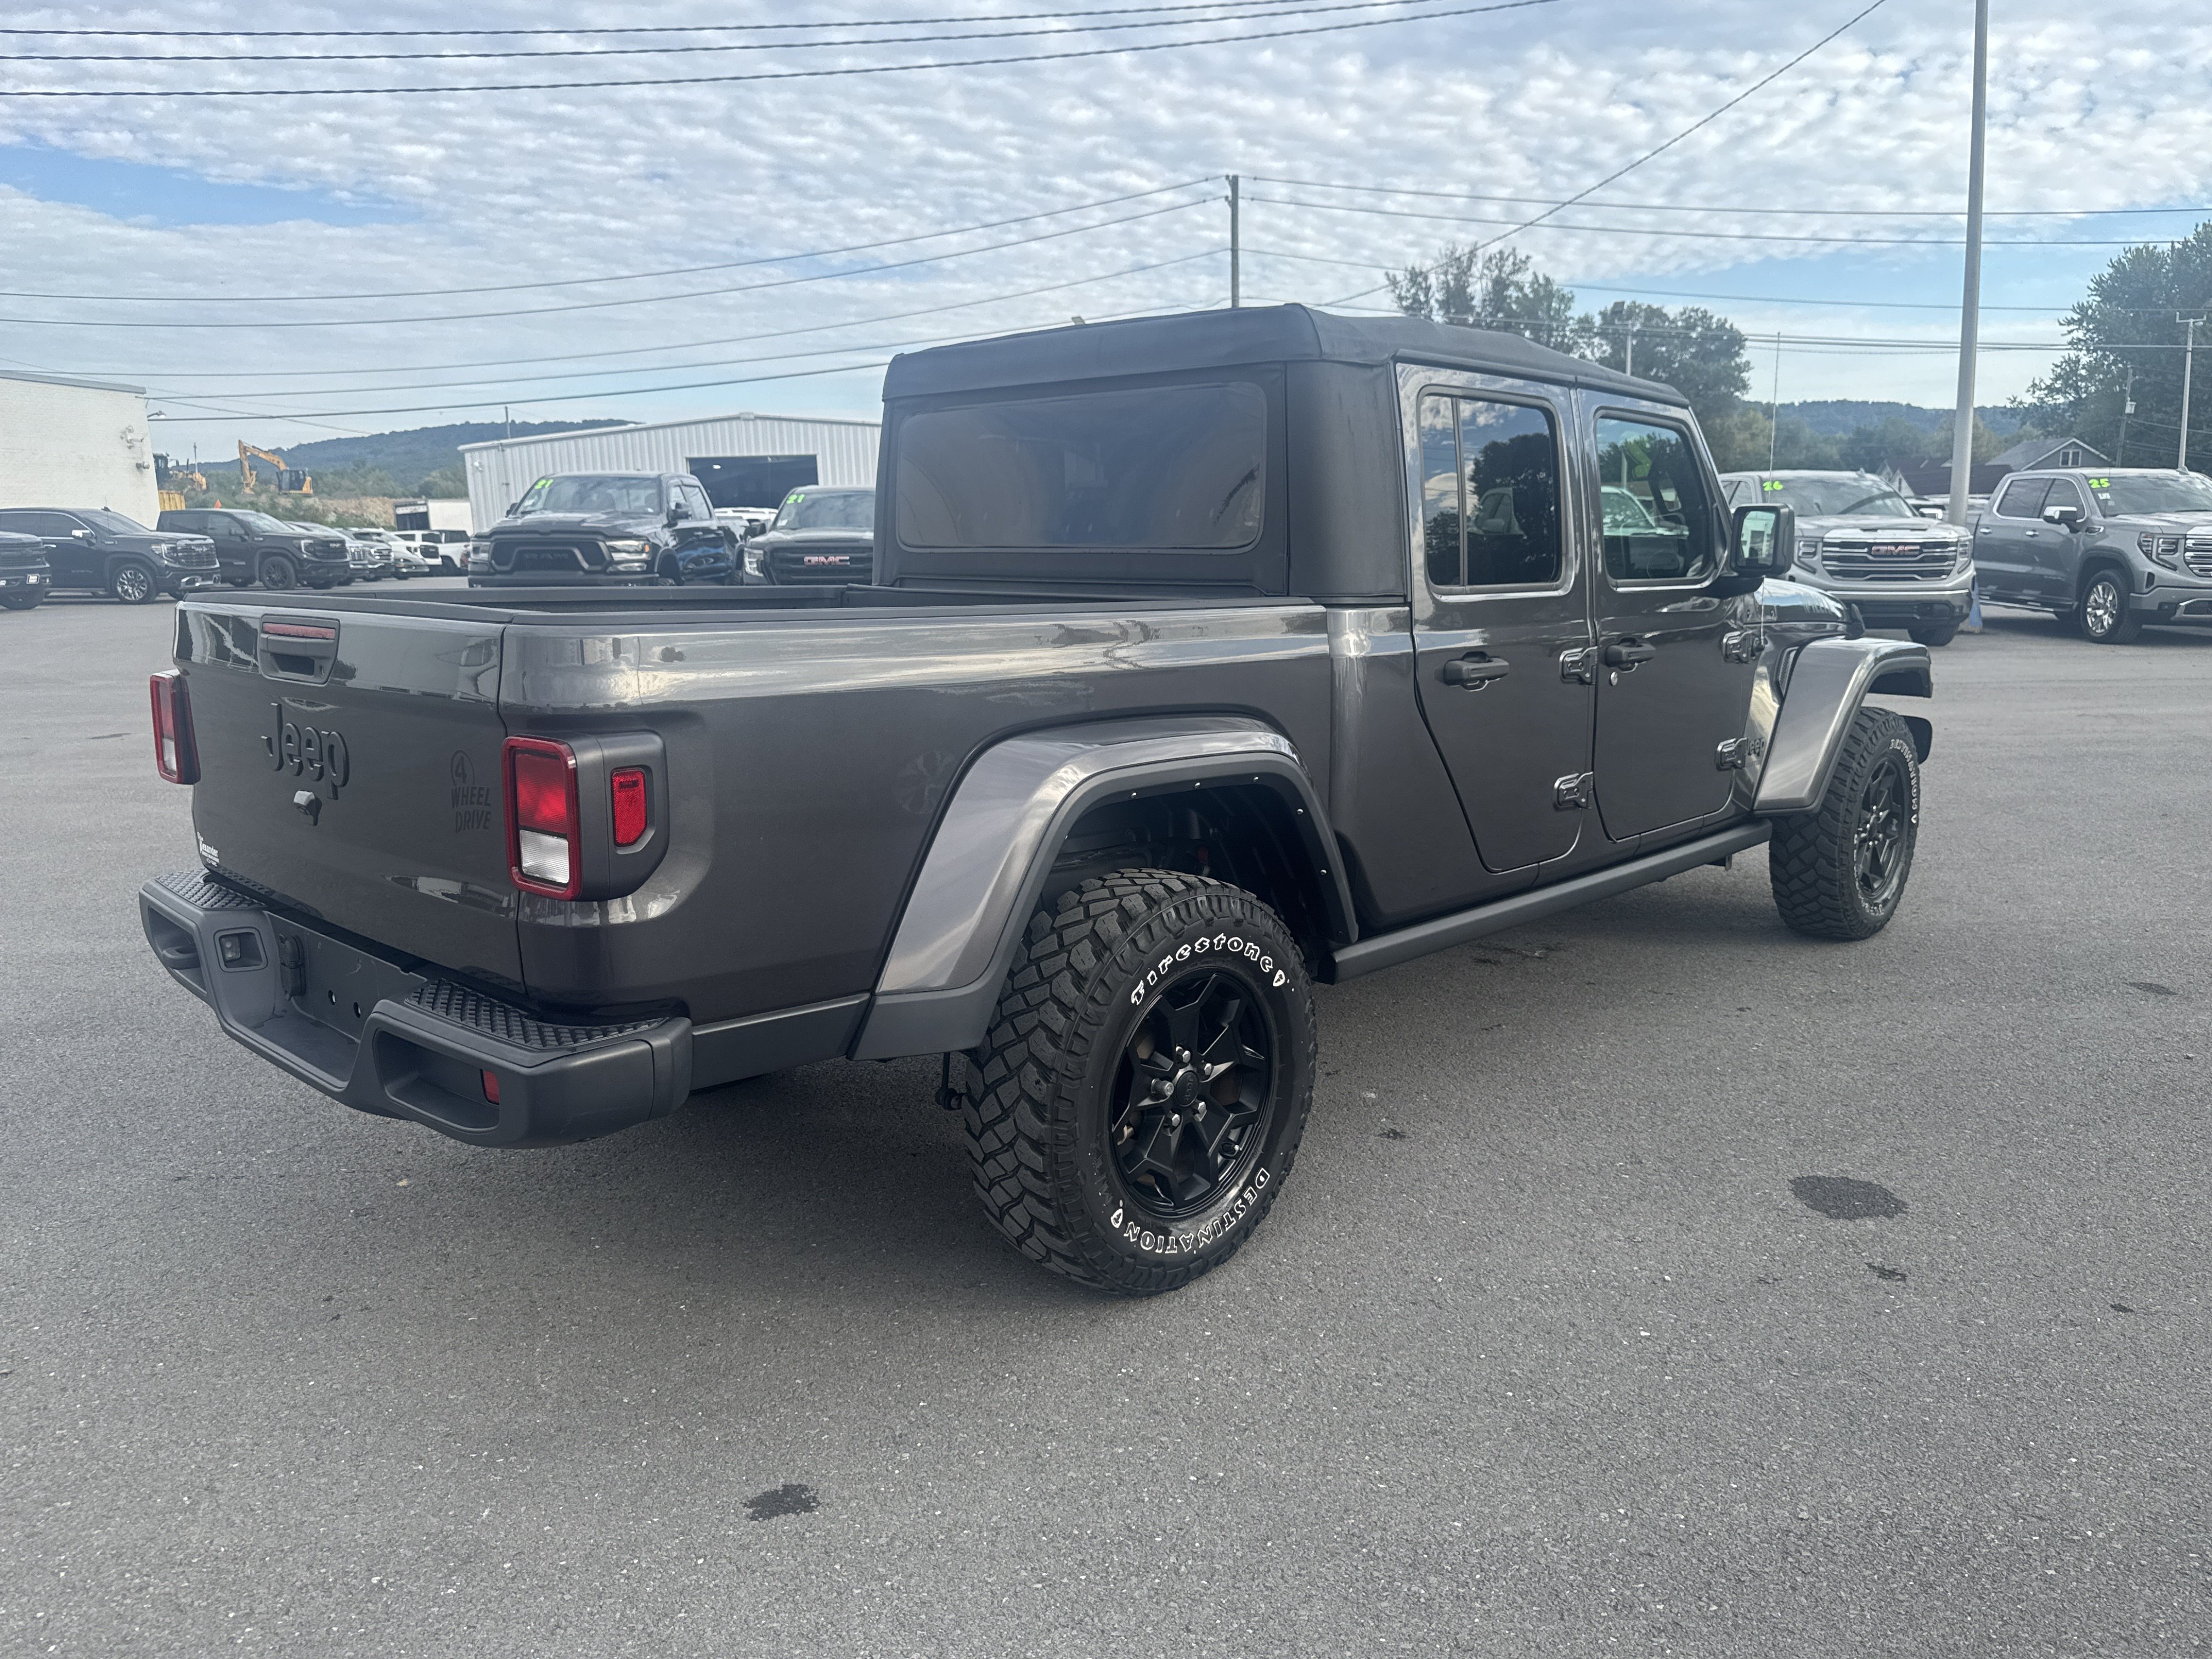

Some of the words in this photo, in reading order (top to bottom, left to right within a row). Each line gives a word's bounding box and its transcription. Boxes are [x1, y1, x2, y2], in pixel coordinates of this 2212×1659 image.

[1763, 481, 1783, 492] 26
[2089, 478, 2111, 488] 25
[786, 494, 805, 504] 21
[1871, 545, 1920, 555] GMC
[804, 556, 850, 566] GMC
[261, 703, 350, 800] Jeep
[454, 755, 467, 785] 4
[451, 786, 491, 809] WHEEL
[455, 809, 491, 833] DRIVE
[1123, 1167, 1271, 1254] DESTINATION
